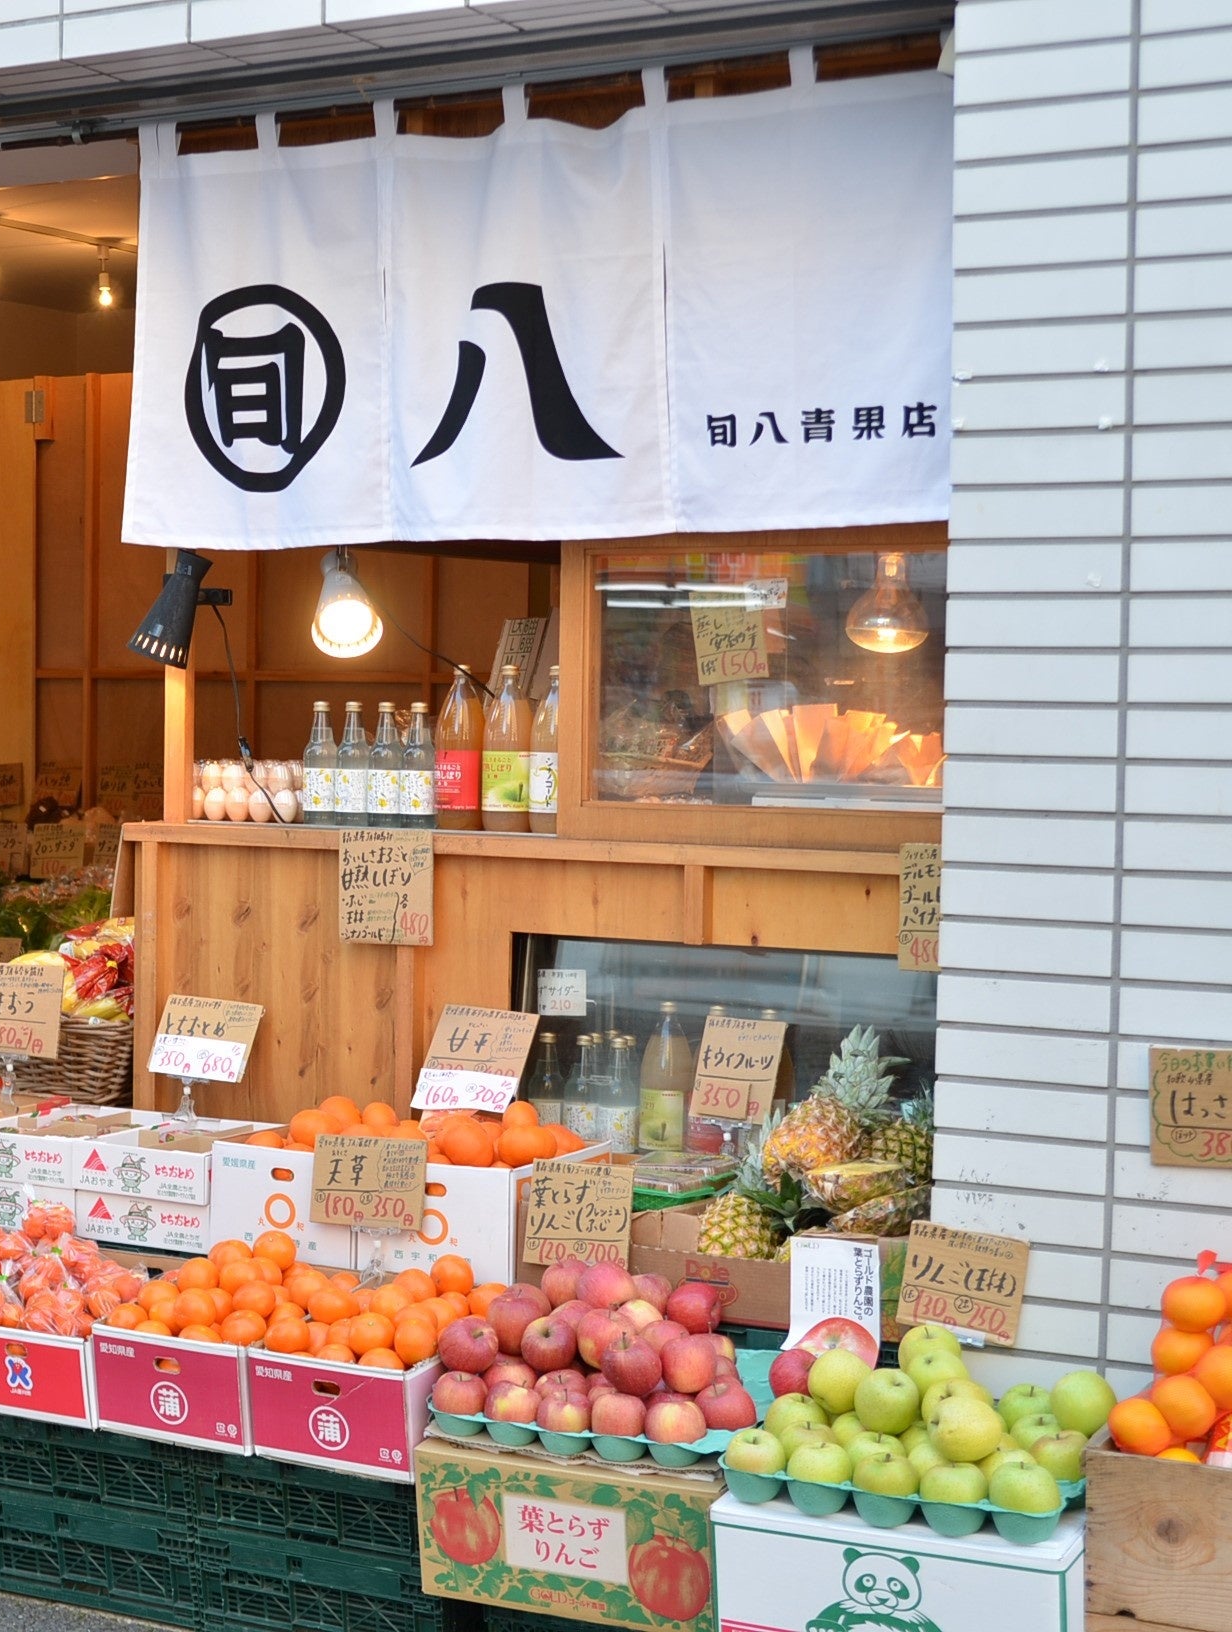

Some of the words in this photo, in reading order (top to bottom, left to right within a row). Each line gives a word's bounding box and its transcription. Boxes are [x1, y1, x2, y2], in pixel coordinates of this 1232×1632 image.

[410, 282, 626, 467] 八
[706, 402, 939, 448] 旬八青果店
[343, 845, 408, 867] おいしさまるごと
[164, 1012, 225, 1038] とちおとめ
[447, 1026, 492, 1054] 甘平
[702, 1044, 774, 1071] キウイフルーツ
[24, 1149, 63, 1165] とちおとめ
[1199, 1131, 1232, 1158] 38
[154, 1164, 195, 1180] とちおとめ
[222, 1156, 257, 1170] 愛媛県産
[326, 1155, 368, 1187] 天草
[79, 1174, 114, 1188] JAおやま
[532, 1176, 596, 1209] 葉とらず
[85, 1222, 120, 1237] JAおやま
[160, 1213, 201, 1229] とちおとめ
[863, 1248, 874, 1317] ゴールド農園の
[100, 1342, 135, 1358] 愛知県産
[255, 1365, 293, 1382] 愛知県産
[157, 1387, 181, 1418] 蒲
[317, 1412, 342, 1444] 蒲
[518, 1504, 610, 1542] 葉とらず
[534, 1538, 600, 1570] りんご
